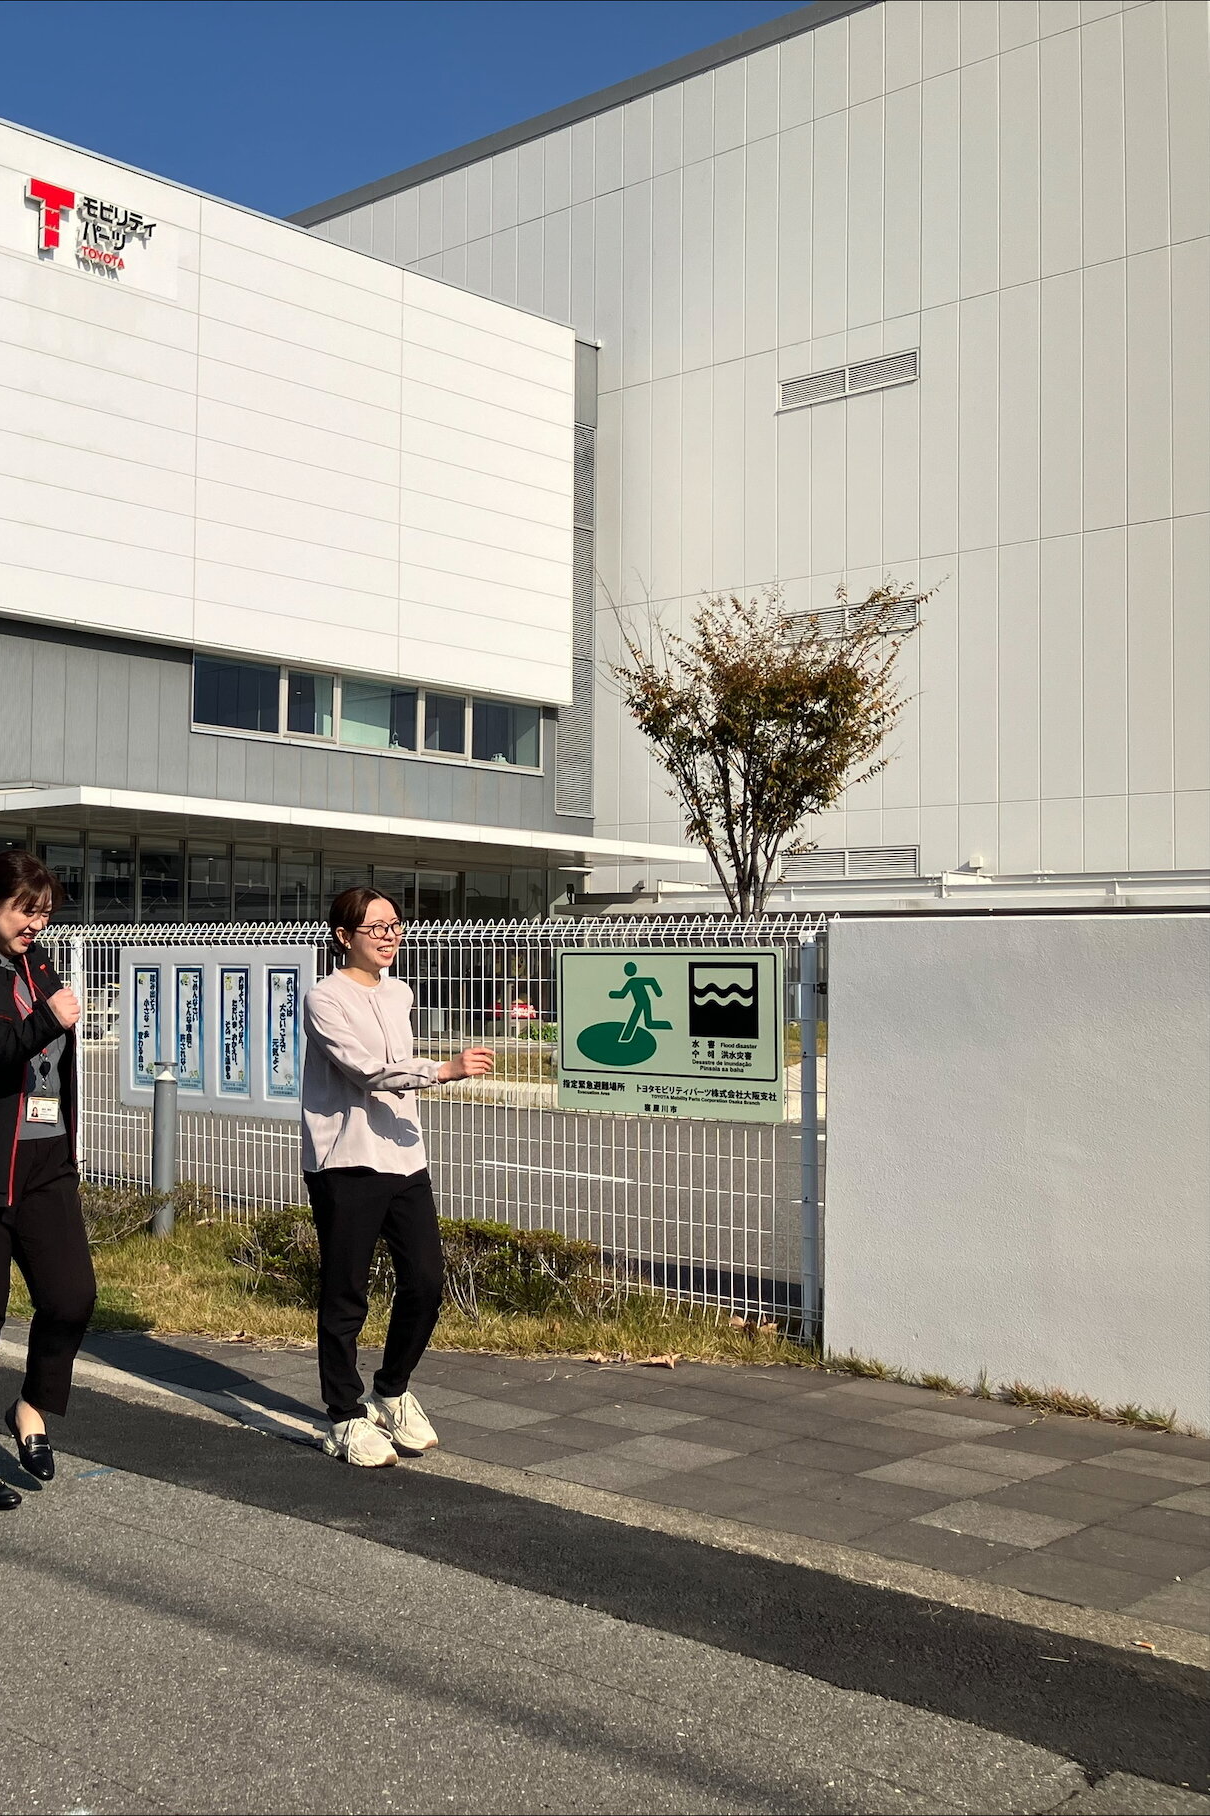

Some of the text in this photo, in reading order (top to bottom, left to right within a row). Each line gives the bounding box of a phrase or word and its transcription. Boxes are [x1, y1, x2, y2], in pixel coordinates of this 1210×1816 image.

[82, 195, 157, 238] モビリティ
[82, 221, 126, 251] パーツ
[81, 245, 126, 270] TOYOTA
[735, 1042, 758, 1050] disaster
[691, 1058, 715, 1066] Desastre
[562, 1078, 626, 1092] 指定緊急避難場所
[635, 1083, 778, 1102] トヨタモビリティパーツ株式会社大阪支社
[643, 1103, 678, 1114] 寝屋川市
